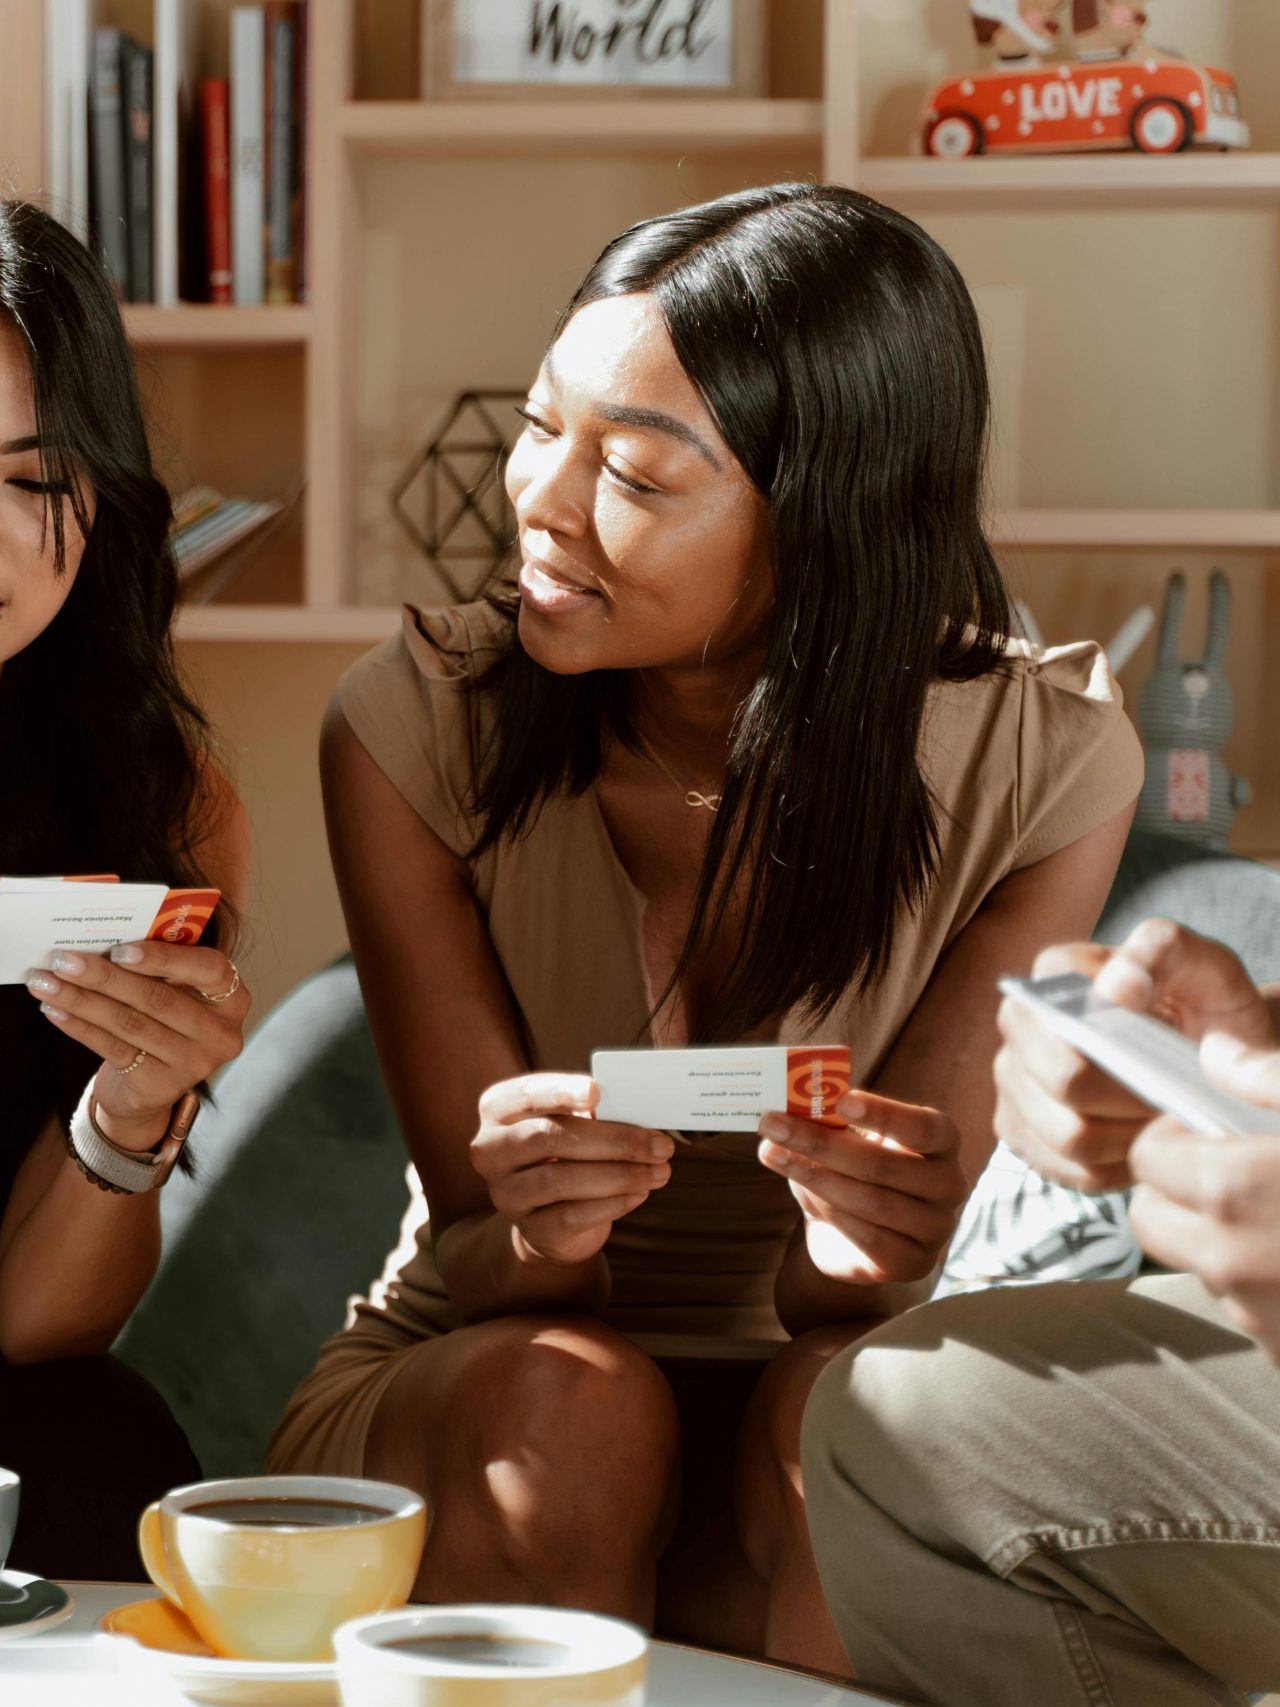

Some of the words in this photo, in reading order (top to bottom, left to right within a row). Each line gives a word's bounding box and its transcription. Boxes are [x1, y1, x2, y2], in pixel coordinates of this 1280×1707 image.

[528, 0, 718, 63] World
[1019, 77, 1123, 122] LOVE
[810, 1095, 825, 1119] twist
